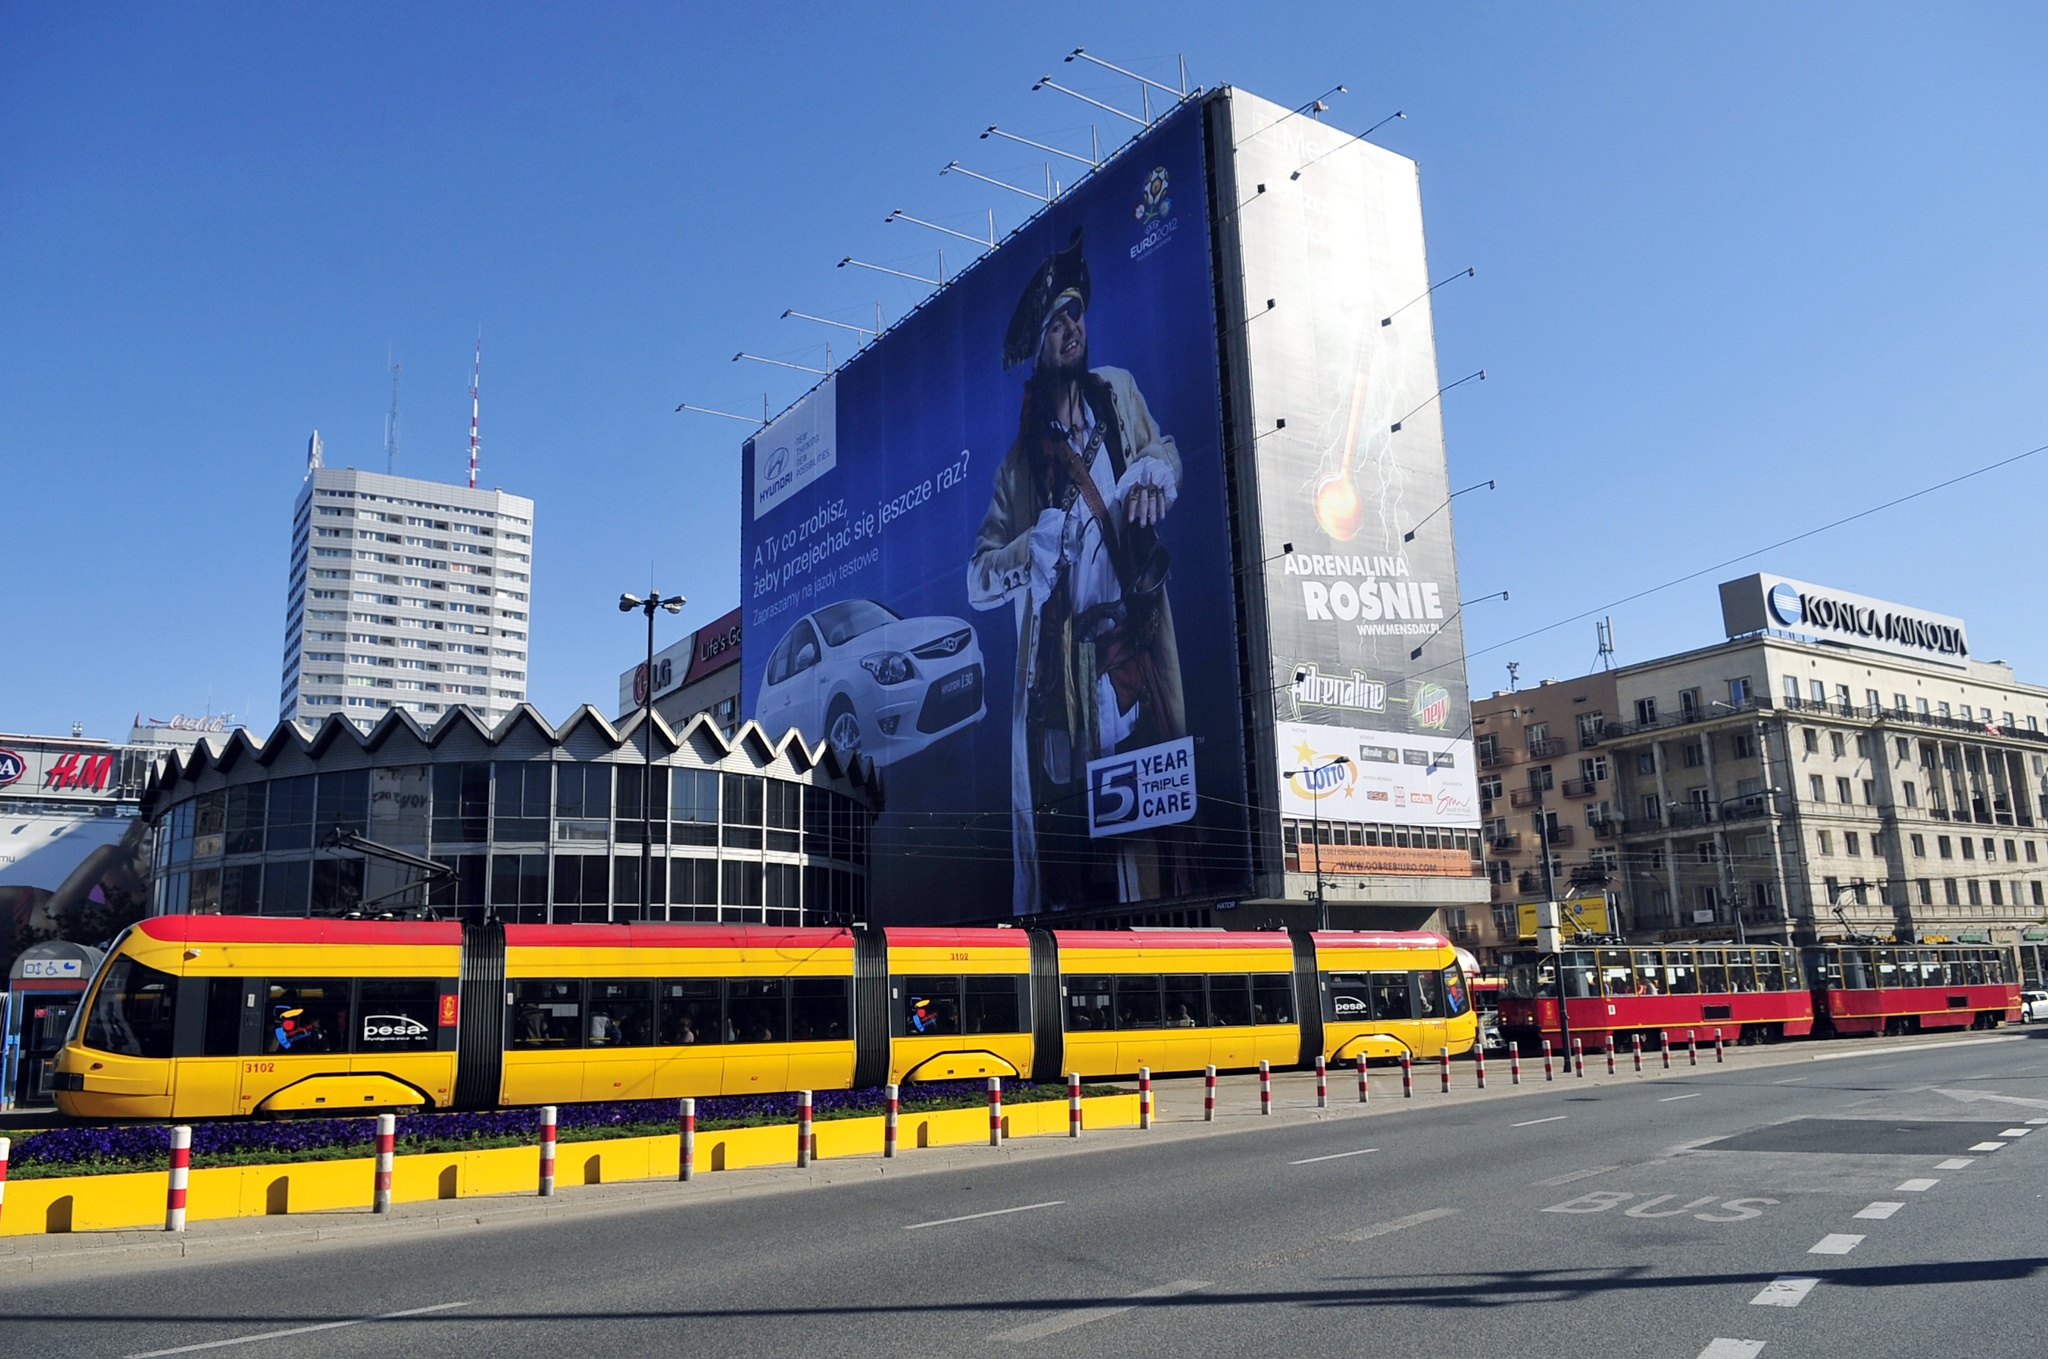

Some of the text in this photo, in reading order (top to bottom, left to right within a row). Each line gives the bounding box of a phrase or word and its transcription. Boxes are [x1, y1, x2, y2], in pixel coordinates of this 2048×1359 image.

[760, 471, 793, 503] HYUNDAI
[753, 449, 970, 599] żeby przejechać się jeszcze raz?
[753, 498, 848, 570] A Ty co zrobisz,
[1284, 554, 1410, 577] ADRENALINA
[753, 547, 879, 626] Zapraszamy na jazdy testowe
[1302, 576, 1444, 621] ROŚNIE
[1356, 623, 1442, 635] WWW.MENSDAY.PL
[1802, 593, 1969, 657] KONICA MINOLTA
[701, 633, 726, 661] Life's
[651, 658, 672, 693] LG
[1287, 664, 1386, 714] Adrenaline
[47, 751, 114, 790] H&M
[1142, 774, 1190, 794] TRIPLE
[1303, 764, 1345, 790] LOTTO
[1096, 749, 1188, 824] 5 YEAR
[1143, 791, 1191, 818] CARE
[950, 953, 969, 961] 3102
[364, 1026, 421, 1039] pesa
[245, 1063, 274, 1073] 3102
[1540, 1191, 1781, 1222] BUS
